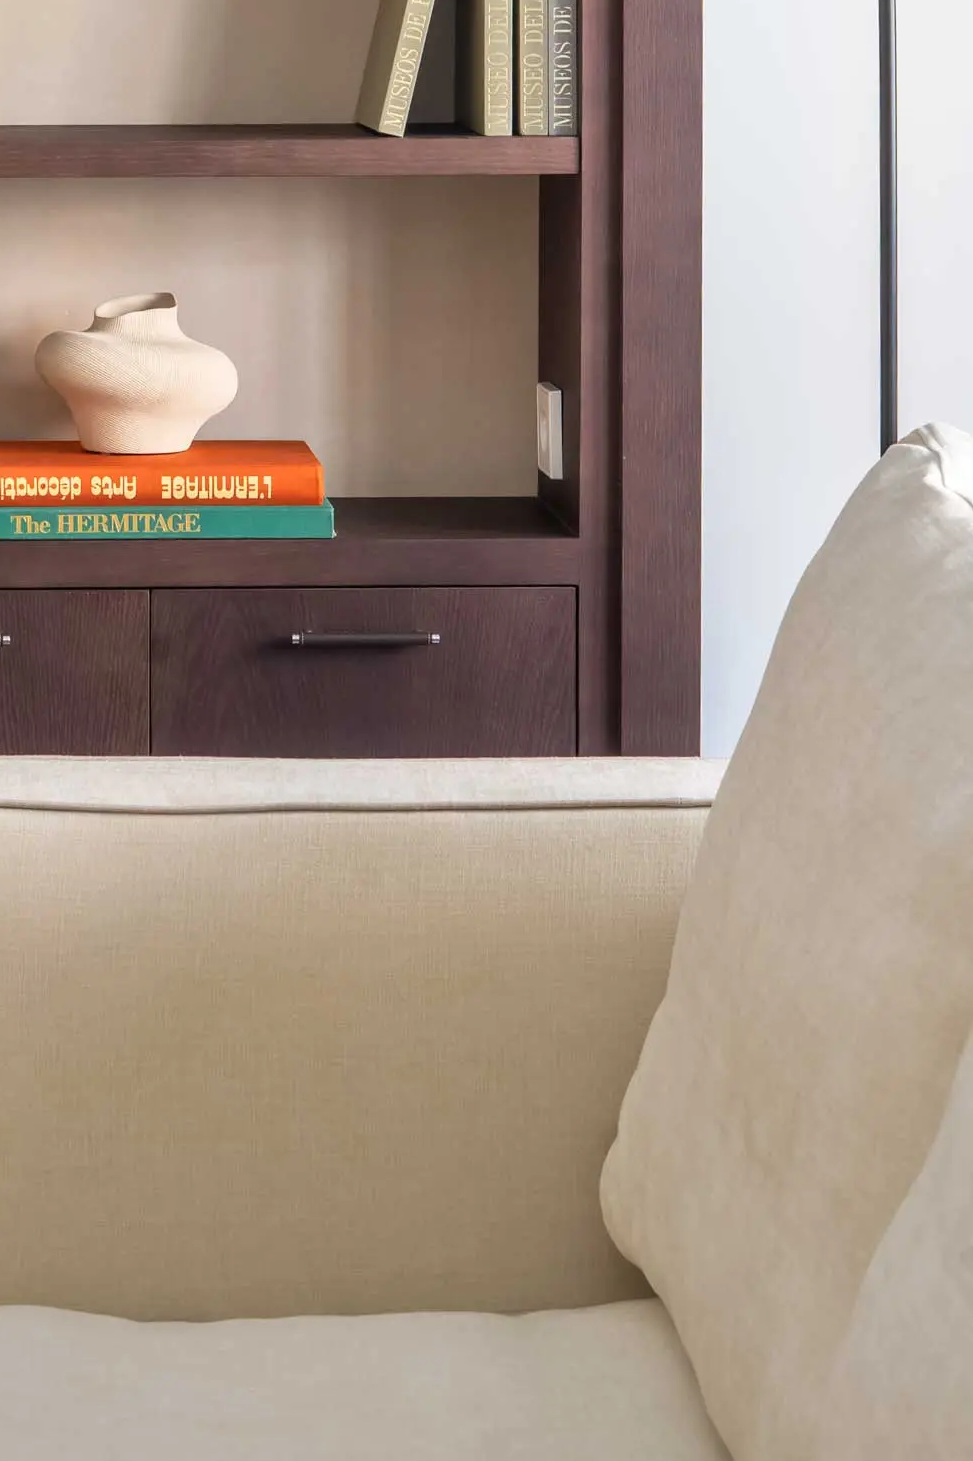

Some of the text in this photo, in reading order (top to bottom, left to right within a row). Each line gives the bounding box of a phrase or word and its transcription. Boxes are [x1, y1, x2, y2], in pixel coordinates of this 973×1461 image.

[524, 0, 544, 44] DEL
[553, 5, 572, 35] DE
[383, 48, 419, 128] MUSEOS
[404, 6, 426, 42] DE
[553, 42, 572, 128] MUSEOS
[487, 53, 509, 132] MUSEO
[522, 53, 544, 132] MUSEO
[90, 476, 136, 498] Arts
[161, 475, 272, 499] L'ERMITAGE
[10, 512, 201, 534] The HERMITAGE
